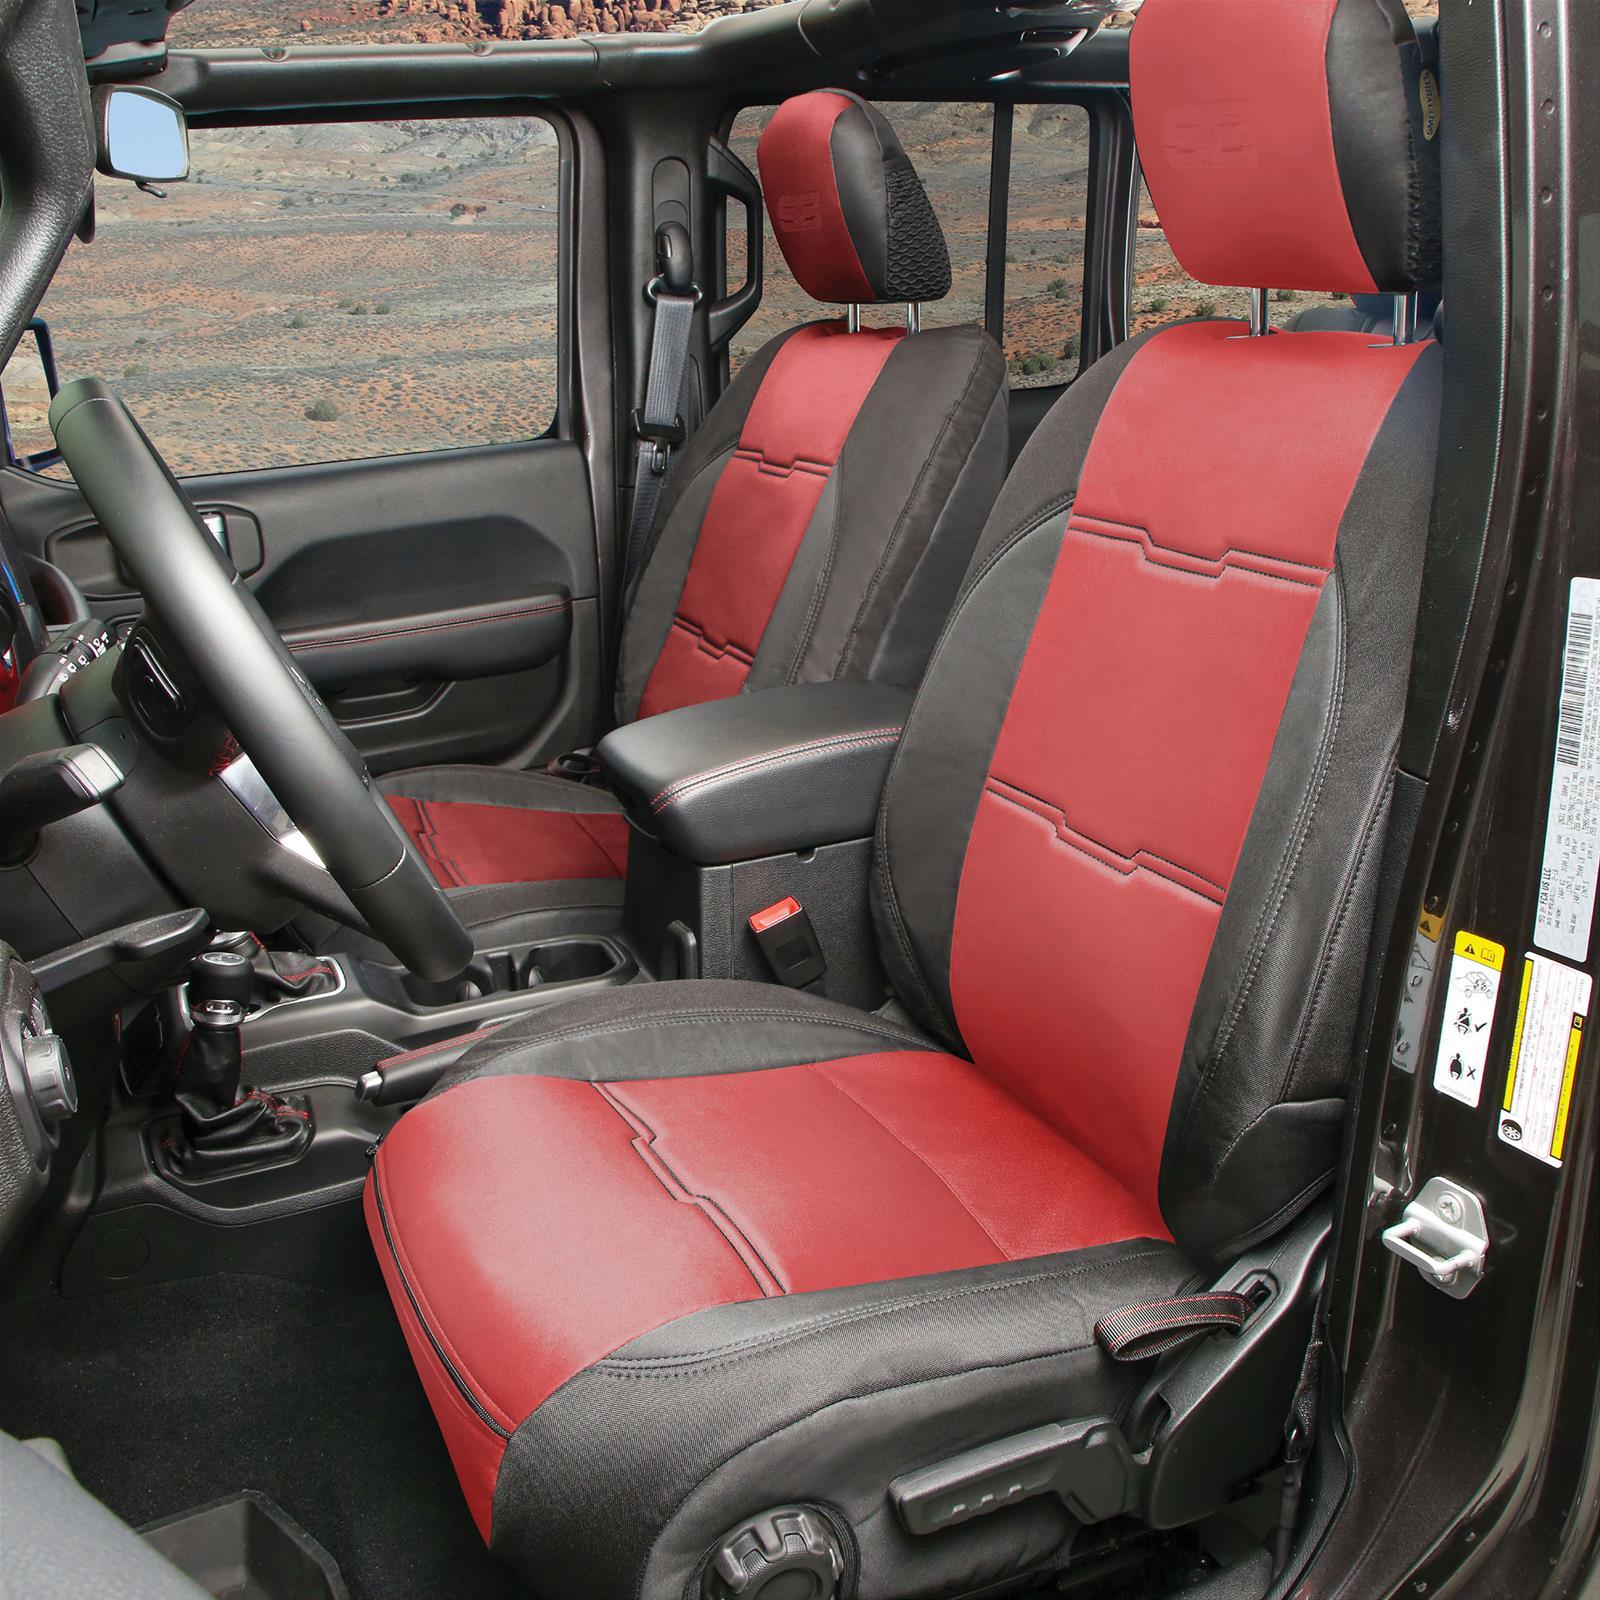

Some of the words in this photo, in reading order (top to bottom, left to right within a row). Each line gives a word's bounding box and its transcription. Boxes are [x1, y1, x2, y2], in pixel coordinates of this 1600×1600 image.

[1542, 867, 1551, 879] LLC
[1541, 880, 1549, 890] US
[1539, 891, 1548, 904] FCA
